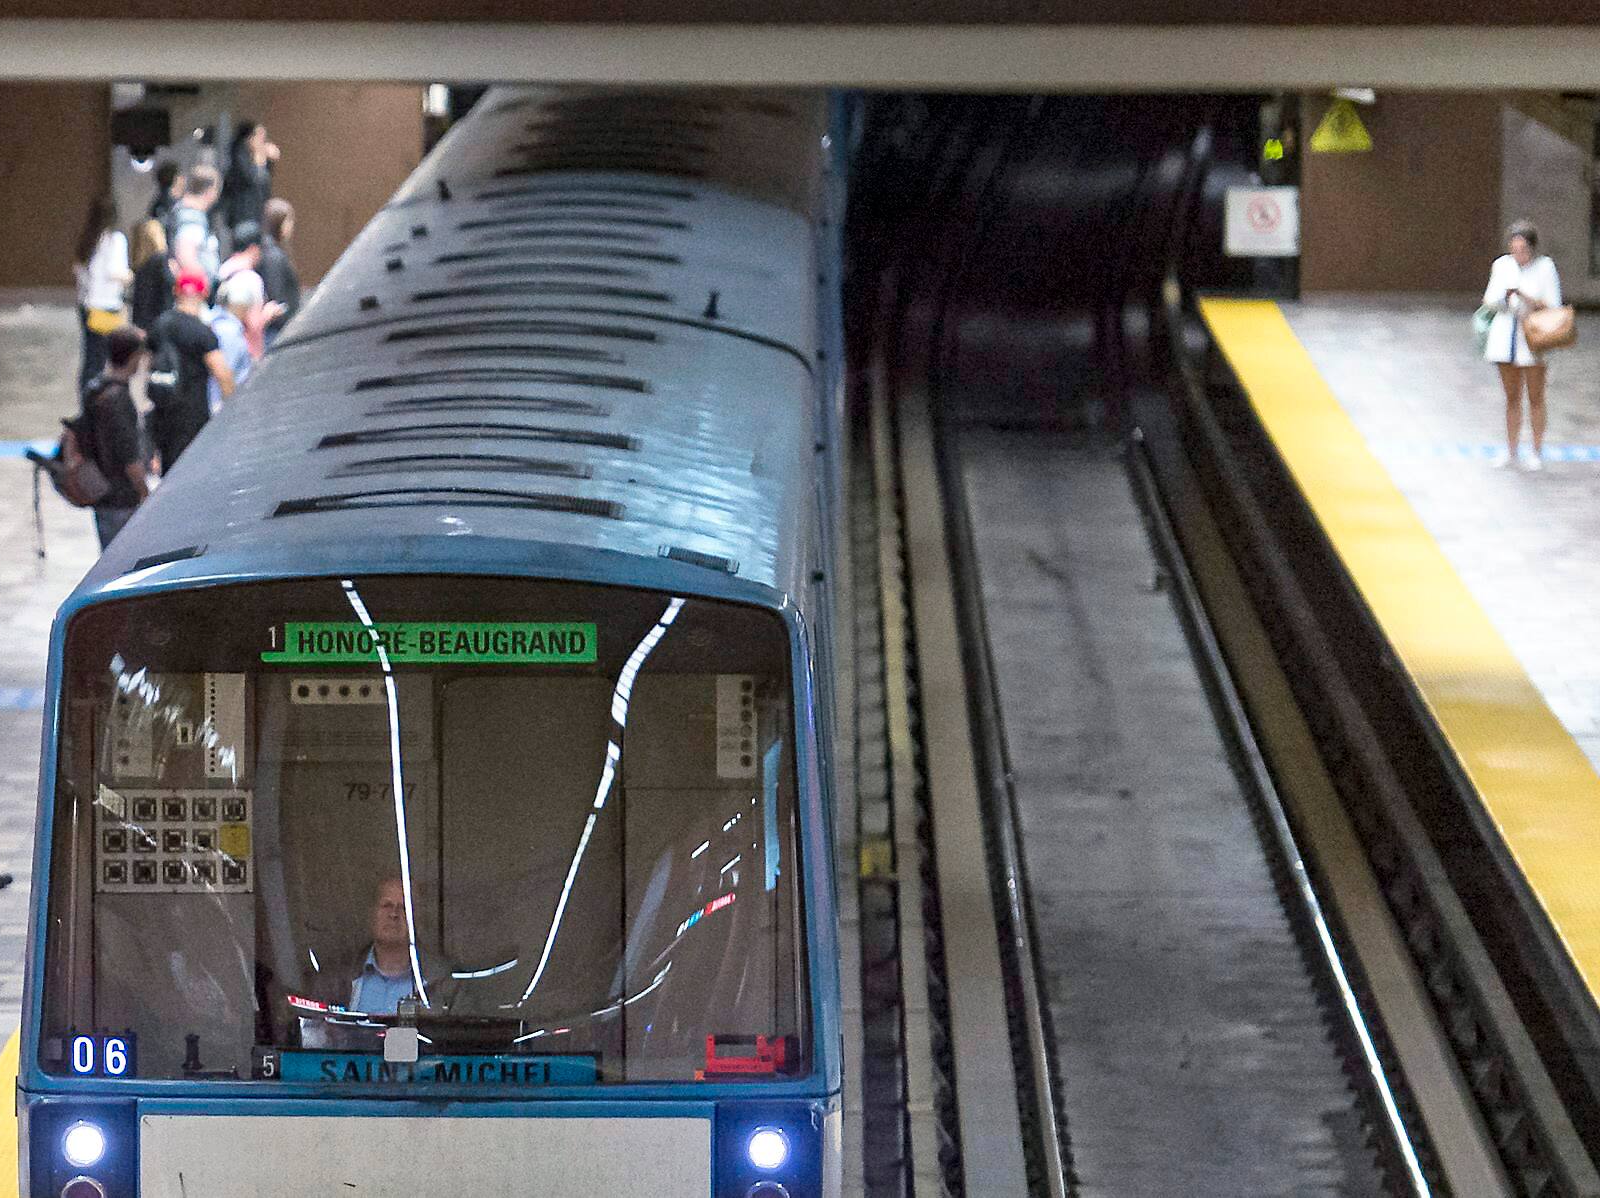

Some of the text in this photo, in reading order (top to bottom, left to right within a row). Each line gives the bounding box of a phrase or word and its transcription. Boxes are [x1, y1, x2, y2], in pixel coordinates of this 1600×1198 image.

[267, 626, 277, 649] 1
[344, 781, 418, 802] 79-77
[72, 1036, 127, 1075] 06
[262, 1055, 275, 1078] 5
